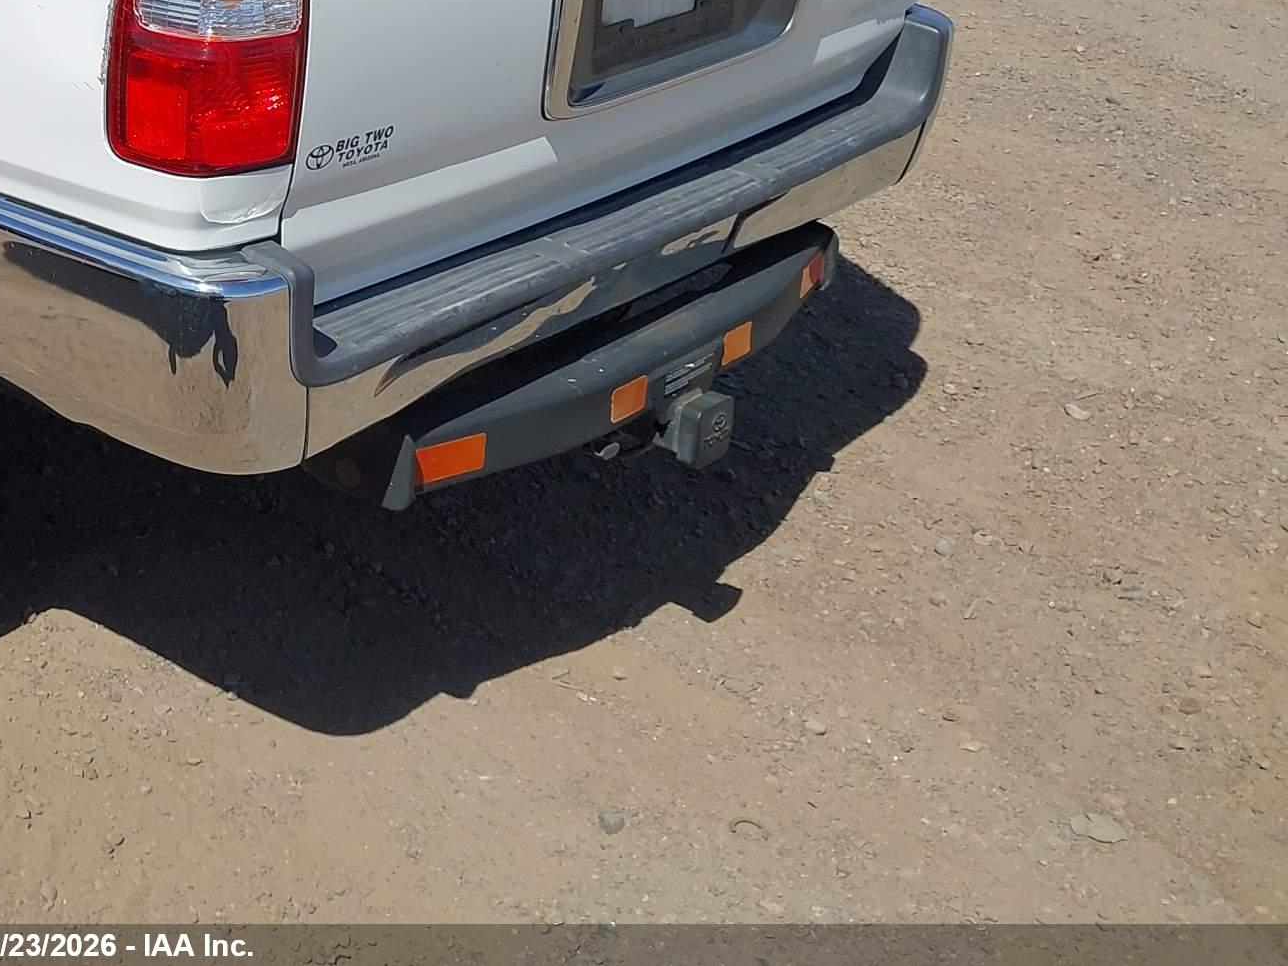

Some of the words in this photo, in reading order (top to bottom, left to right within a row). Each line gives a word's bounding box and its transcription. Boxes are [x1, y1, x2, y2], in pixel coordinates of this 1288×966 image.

[335, 135, 360, 153] BIG
[365, 125, 394, 144] TWO
[338, 139, 388, 162] TOYOTA
